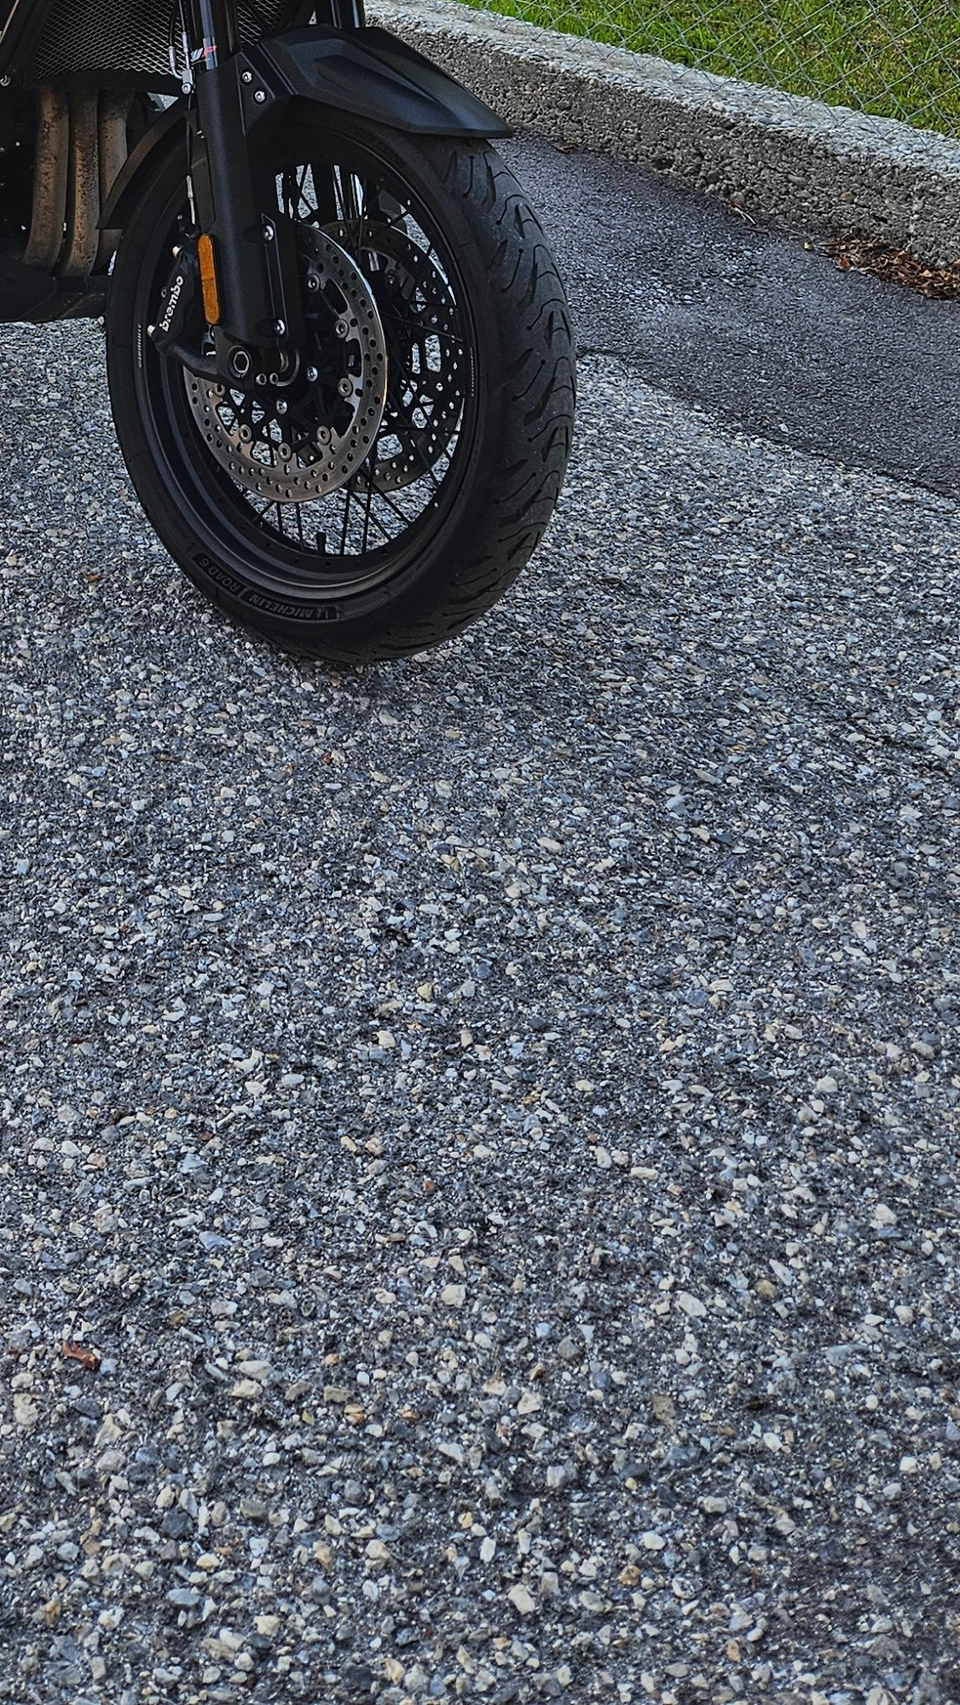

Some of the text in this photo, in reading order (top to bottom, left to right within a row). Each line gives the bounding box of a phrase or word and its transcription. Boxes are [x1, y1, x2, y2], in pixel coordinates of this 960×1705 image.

[159, 275, 184, 332] brembo
[198, 557, 314, 618] MICHELIN ROAD 6
